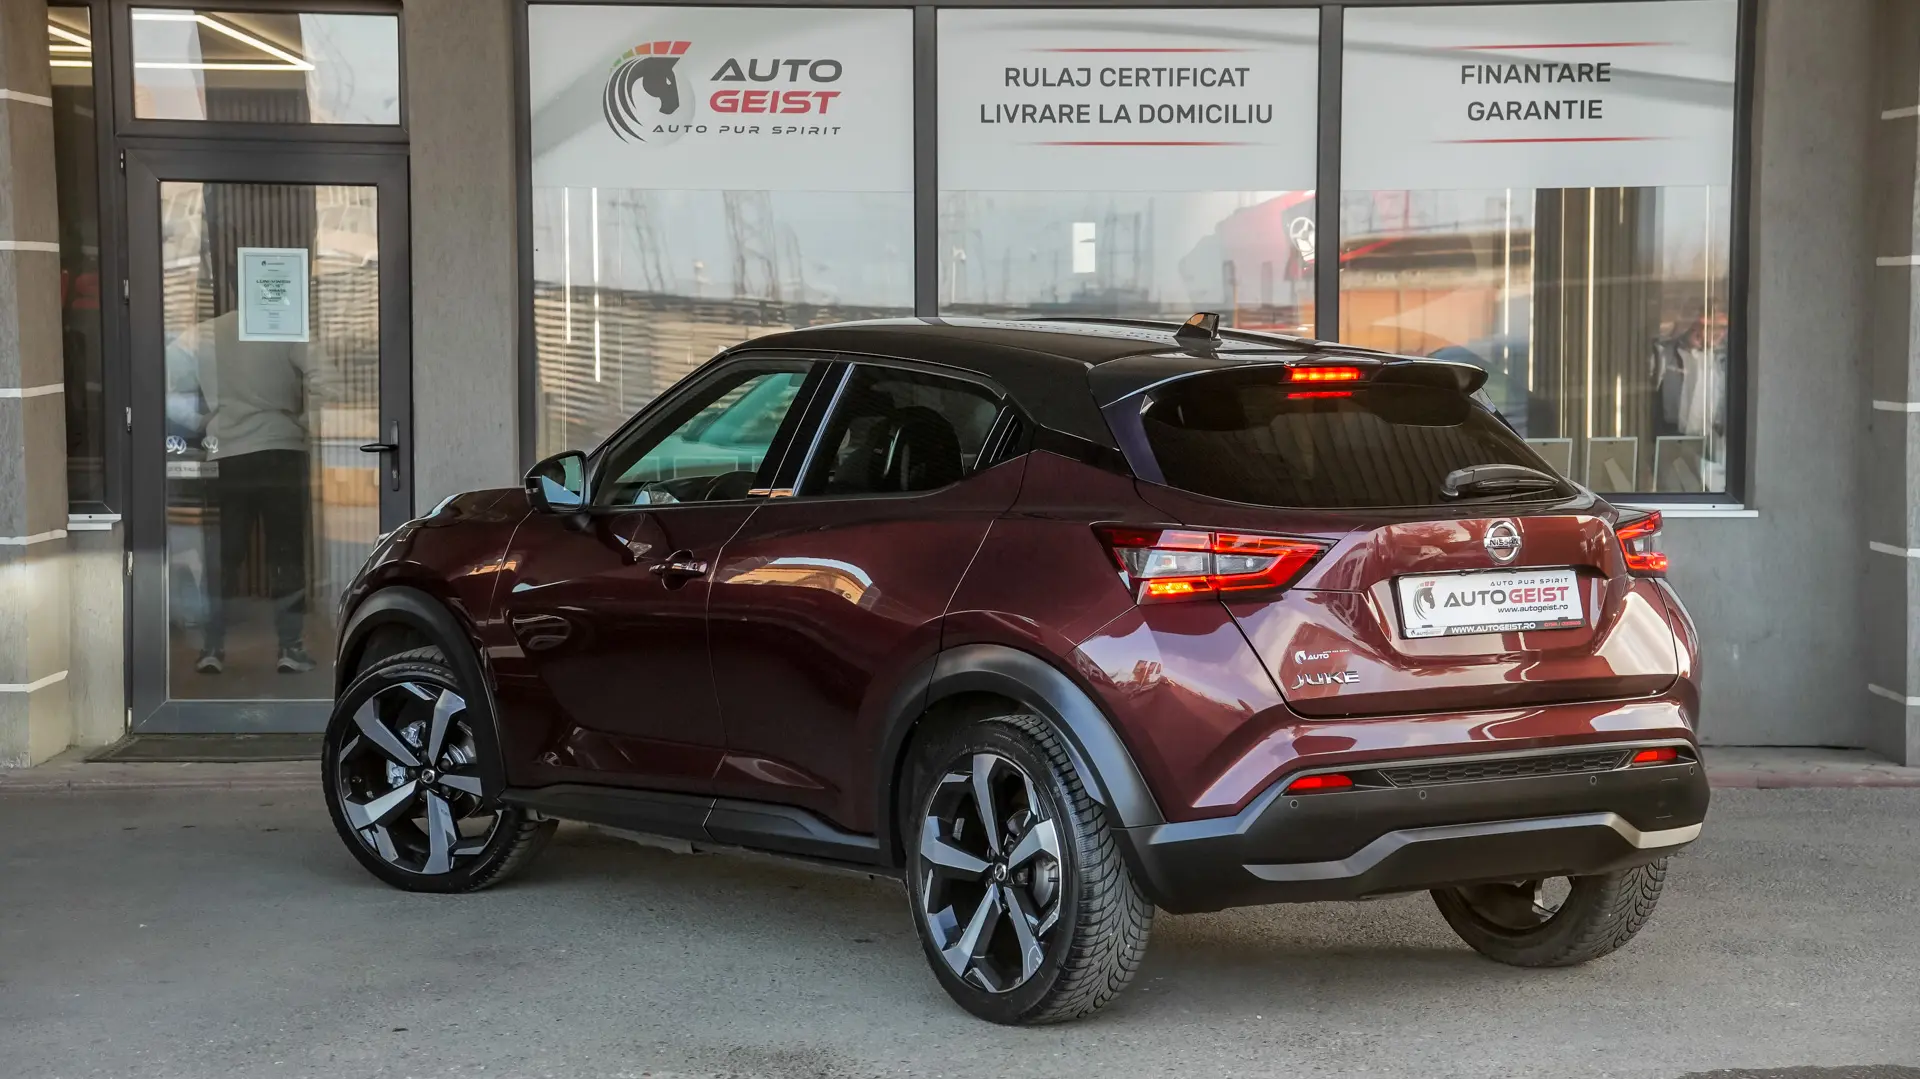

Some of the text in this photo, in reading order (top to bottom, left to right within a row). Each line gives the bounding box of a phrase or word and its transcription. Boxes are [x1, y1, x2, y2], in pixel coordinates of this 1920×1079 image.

[710, 58, 843, 83] AUTO
[1004, 67, 1250, 87] RULAJ CERTIFICAT
[1461, 62, 1611, 84] FINANTARE
[709, 90, 842, 114] GEIST
[1467, 99, 1603, 122] GARANTIE
[980, 104, 1273, 124] LIVRARE LA DOMICILIU
[652, 124, 842, 136] AUTO PUR SPIRIT
[1497, 604, 1569, 613] www.autogeist.ro
[1451, 622, 1536, 634] WWW.AUTOGEIST.RO
[1291, 670, 1361, 690] JUKE
